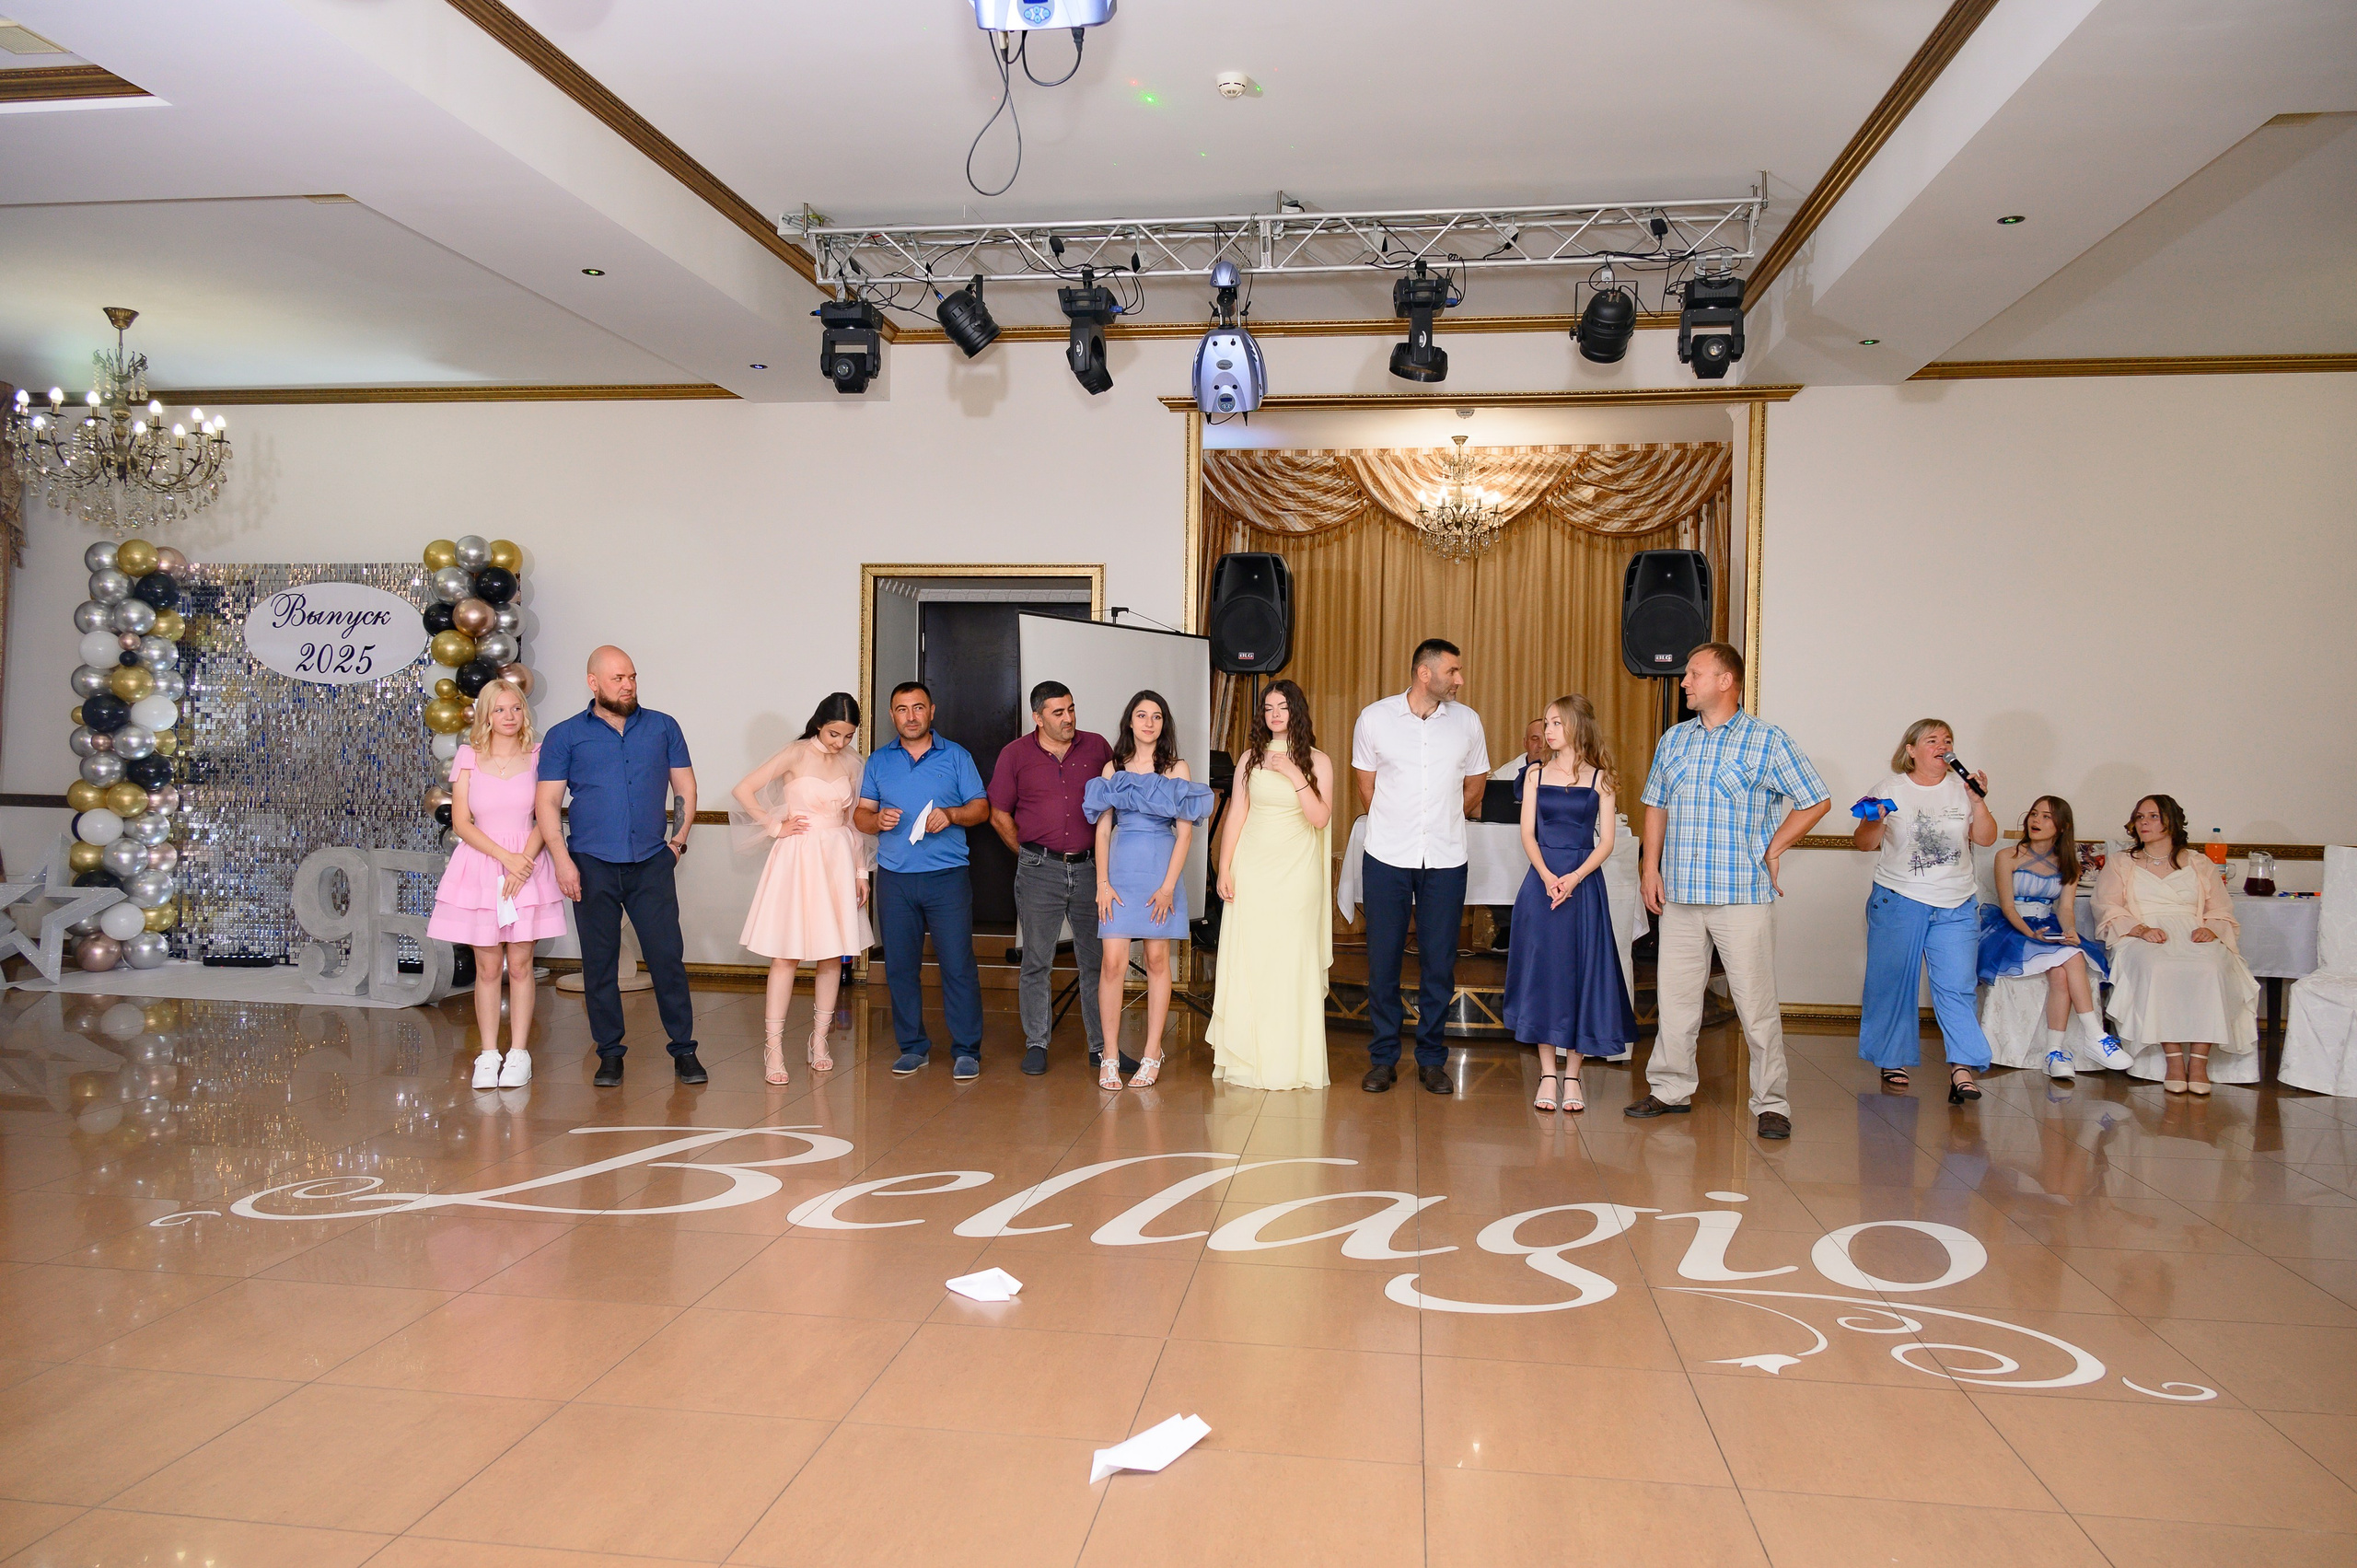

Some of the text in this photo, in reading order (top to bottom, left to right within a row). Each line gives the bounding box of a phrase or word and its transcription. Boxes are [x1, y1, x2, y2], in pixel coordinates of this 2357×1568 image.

[270, 593, 391, 639] Выпуск
[295, 643, 376, 675] 2025
[230, 1124, 1987, 1314] Bellagio
